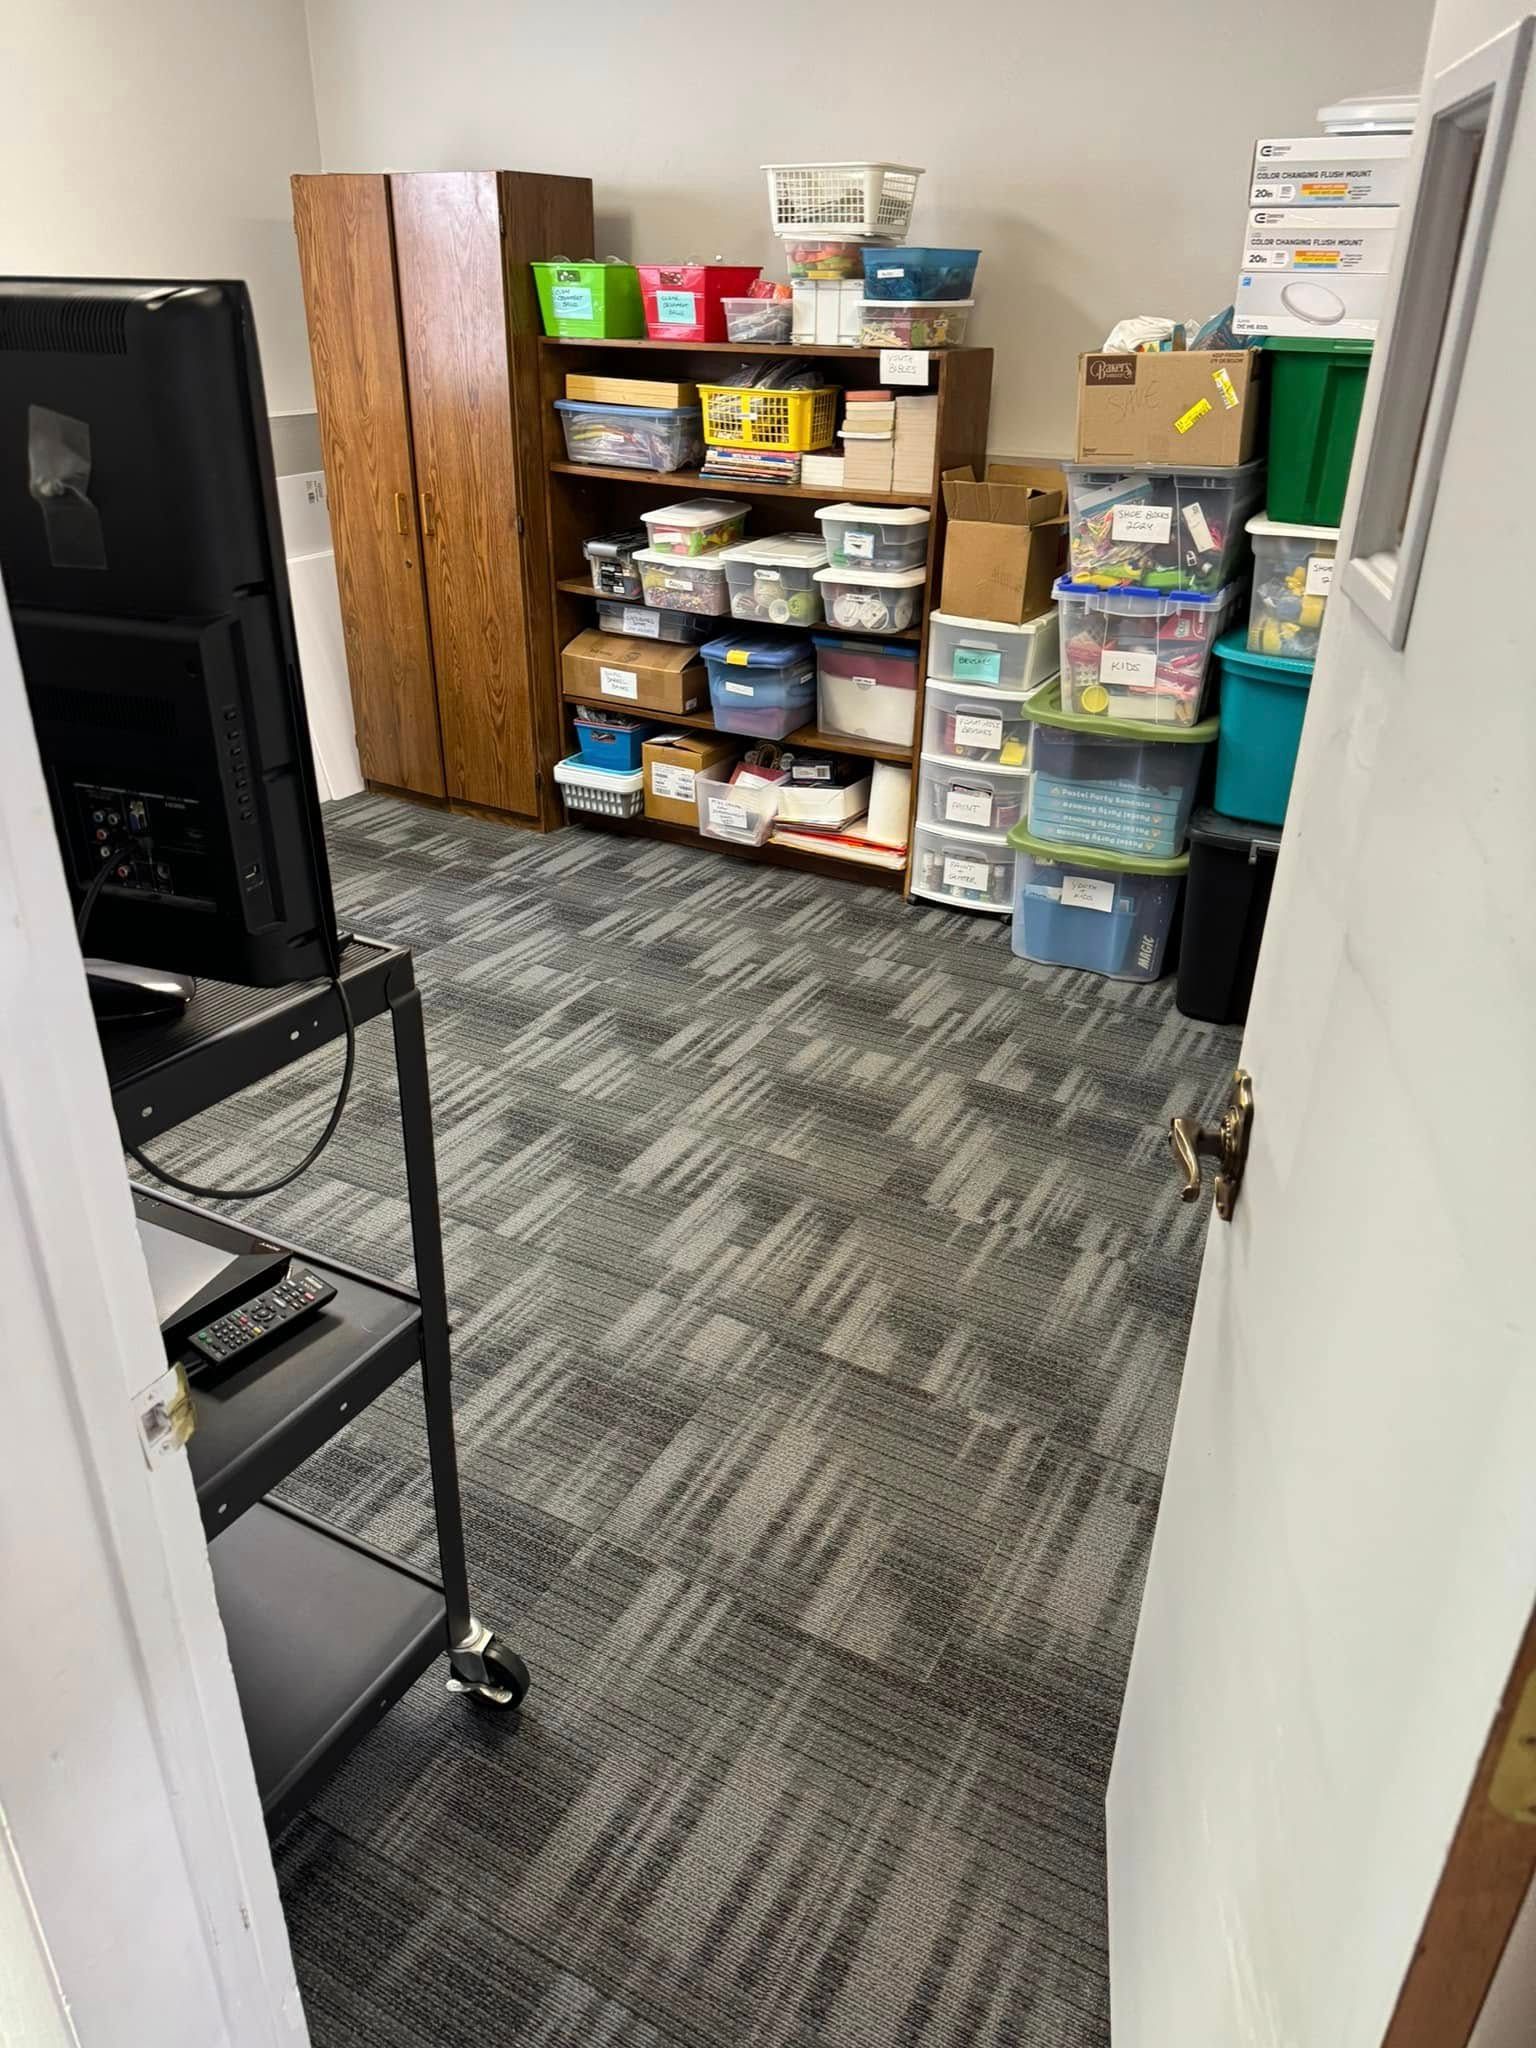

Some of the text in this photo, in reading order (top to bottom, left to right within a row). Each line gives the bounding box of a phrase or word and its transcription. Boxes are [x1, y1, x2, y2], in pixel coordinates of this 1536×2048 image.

[1256, 170, 1372, 180] COLOR CHANGING FLUSH MOUNT
[1255, 189, 1273, 198] 20in
[1249, 254, 1268, 264] 20in
[1118, 510, 1142, 519] SHOE
[1126, 521, 1154, 531] 2024
[1112, 661, 1140, 672] KIDS
[1062, 788, 1089, 799] Pastel
[1089, 791, 1114, 803] Party
[1098, 806, 1121, 817] Party
[1124, 812, 1151, 822] Pastel
[1137, 934, 1155, 970] MAGIC
